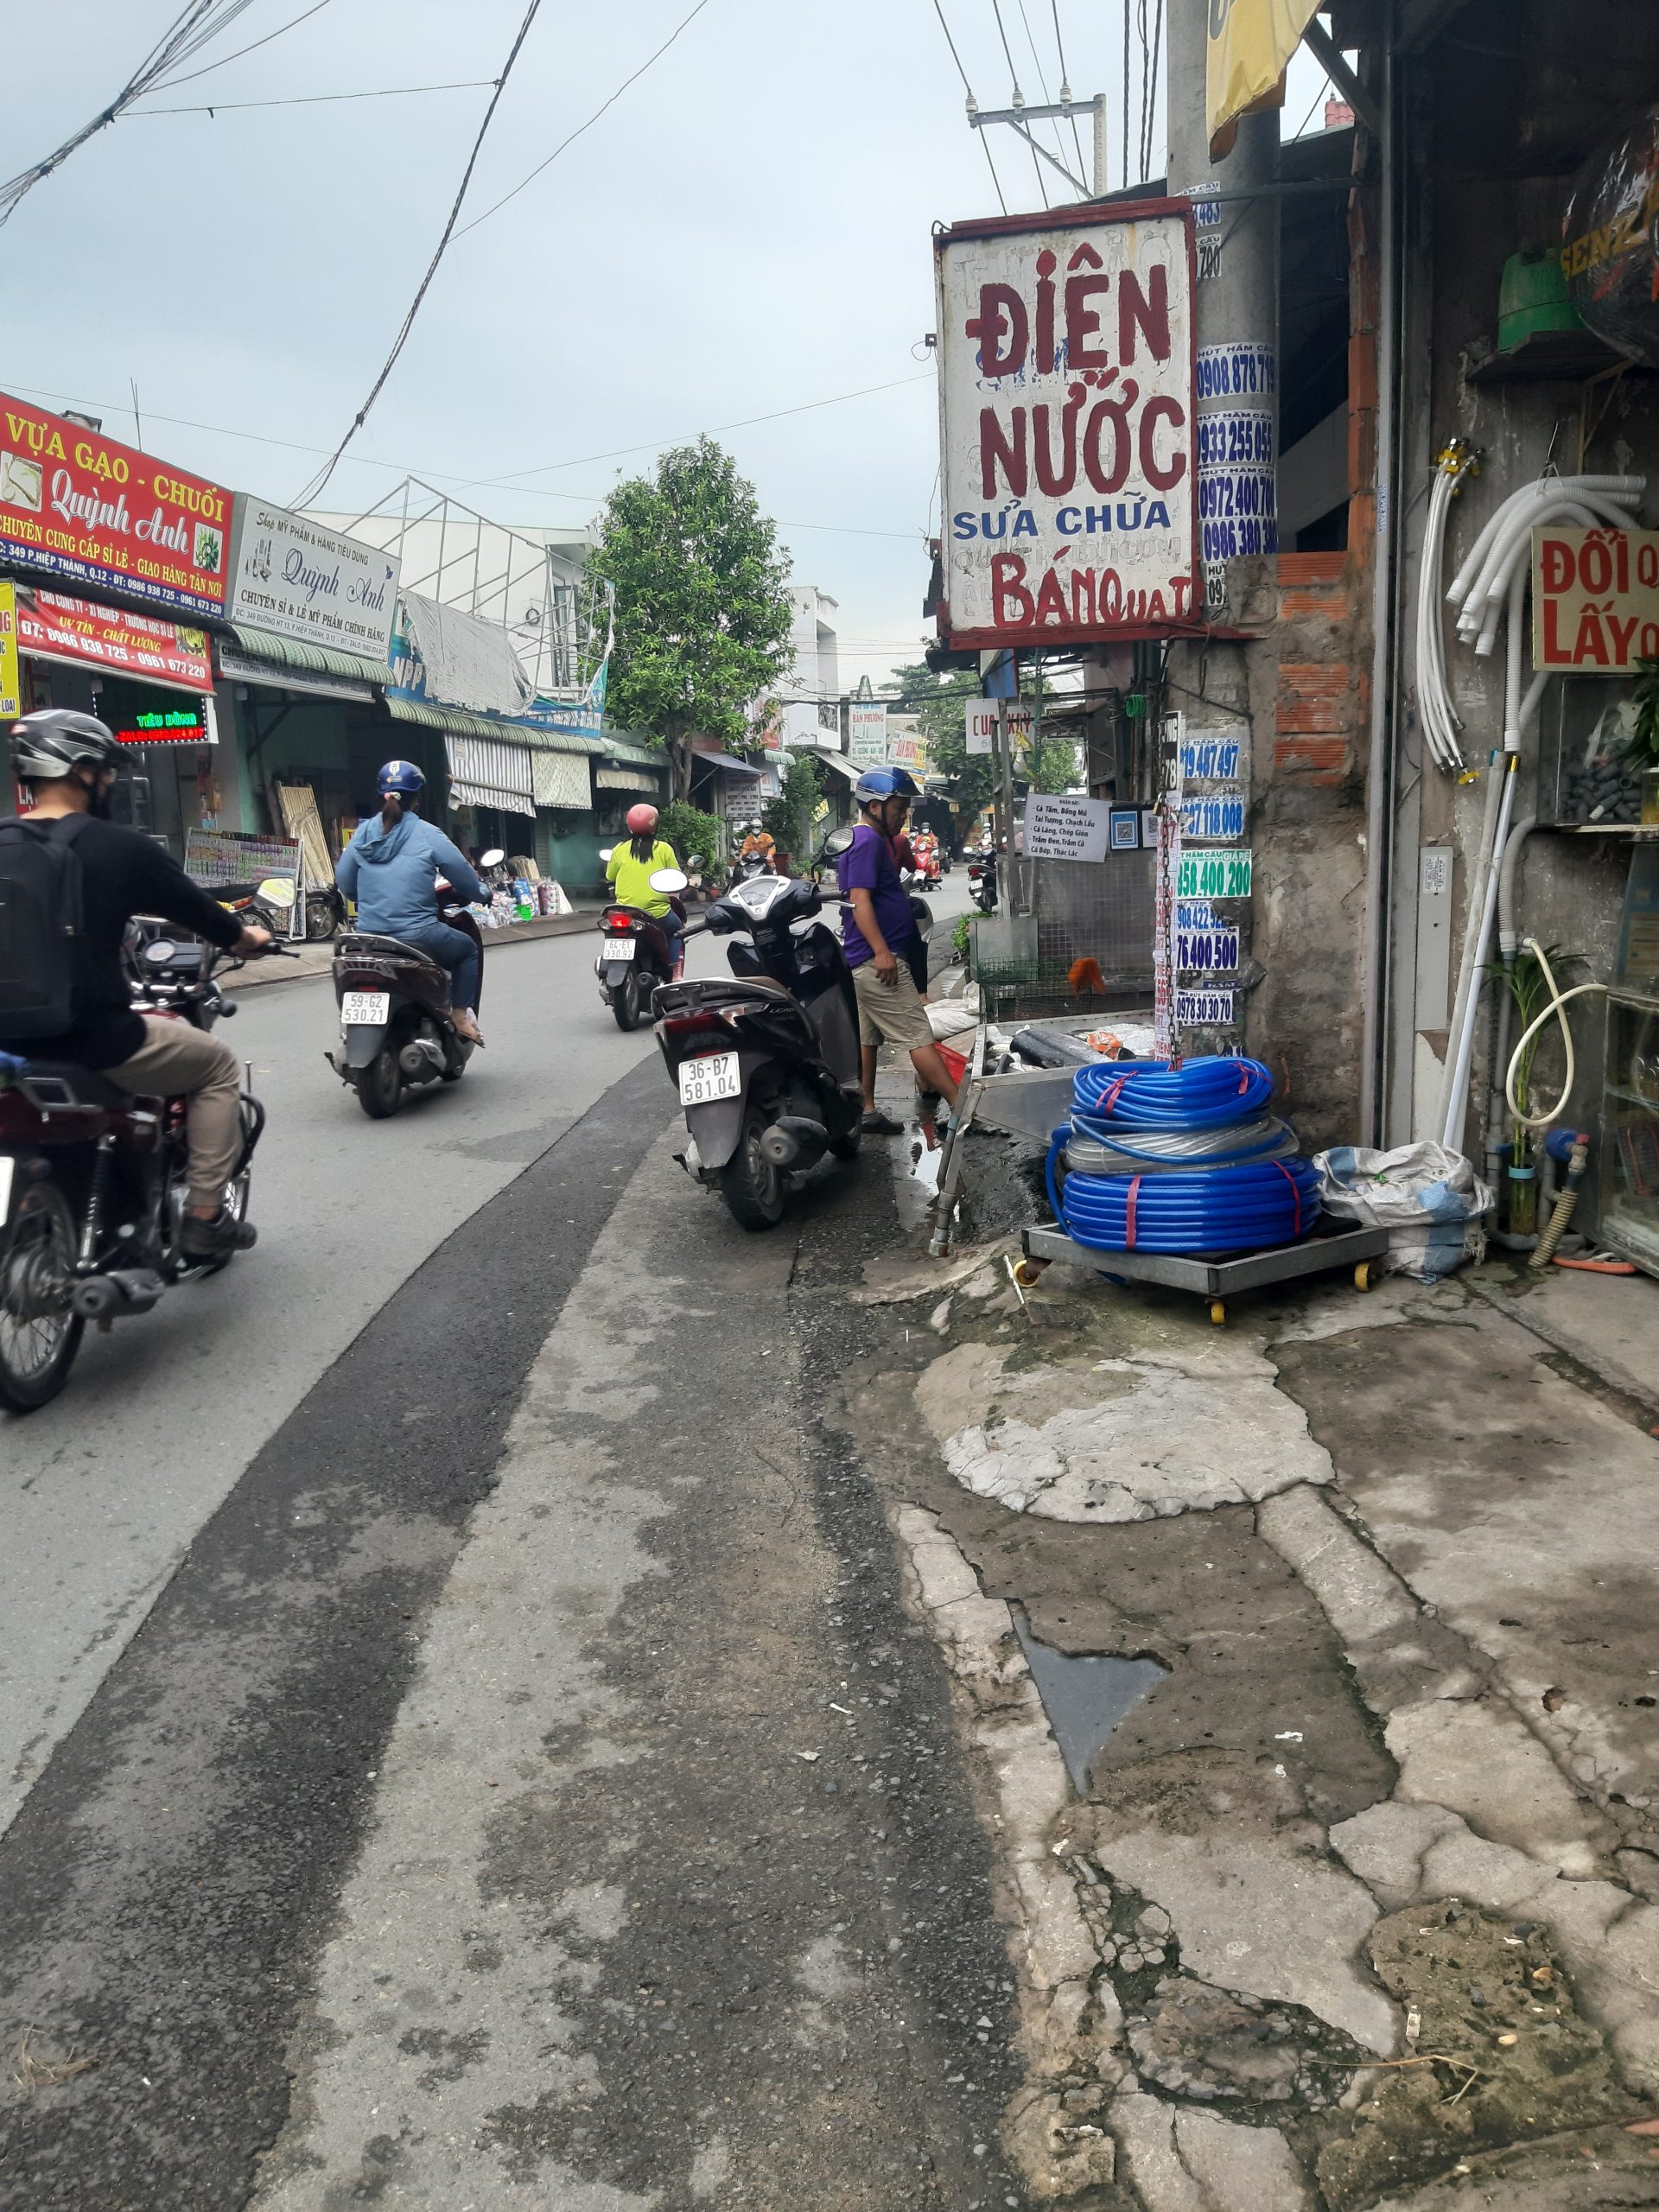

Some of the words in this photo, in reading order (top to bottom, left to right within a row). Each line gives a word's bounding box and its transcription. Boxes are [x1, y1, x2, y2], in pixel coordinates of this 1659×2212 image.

[1198, 347, 1221, 358] HÚT
[979, 366, 1187, 499] NƯỚC
[5, 411, 67, 461] VỰA
[74, 442, 130, 484] GẠO
[153, 474, 225, 523] CHUỐI
[51, 468, 130, 535] Quỳnh
[135, 506, 189, 555] Anh
[953, 499, 1038, 540] SỬA
[1056, 490, 1172, 537] CHỮA
[45, 528, 76, 552] CUNG
[79, 534, 100, 560] CẤP
[115, 546, 129, 569] LẺ
[137, 557, 160, 579] GIAO
[162, 563, 188, 588] HÀNG
[189, 572, 207, 594] TẬN
[207, 580, 223, 598] NƠI
[256, 512, 275, 531] Shop
[276, 521, 289, 534] MỸ
[289, 524, 310, 543] PHẨM
[317, 537, 336, 553] HÀNG
[337, 544, 351, 558] TIÊU
[351, 548, 369, 566] DÙNG
[1540, 529, 1630, 595] ĐỔI
[9, 543, 26, 559] 349
[27, 549, 57, 568] P.HIỆP
[57, 558, 88, 578] THÀNH,
[89, 567, 108, 582] Q.12
[112, 573, 126, 588] ĐT:
[127, 578, 146, 593] 0986
[147, 584, 161, 597] 938
[162, 588, 175, 601] 725
[180, 594, 196, 607] 0961
[197, 599, 210, 610] 673
[210, 603, 223, 614] 220
[40, 589, 55, 603] CHO
[54, 593, 76, 612] CÔNG
[74, 597, 84, 614] TY
[280, 547, 340, 603] Quỳnh
[346, 577, 385, 612] Anh
[991, 544, 1096, 629] BÁN
[59, 615, 75, 628] UY
[102, 628, 129, 645] CHẤT
[130, 637, 162, 654] LƯỢNG
[240, 589, 276, 610] CHUYÊN
[288, 602, 295, 615] &
[296, 604, 308, 620] LẺ
[308, 609, 321, 623] MỸ
[321, 611, 344, 631] PHẨM
[345, 619, 366, 637] CHÍNH
[246, 611, 257, 620] 349
[1542, 599, 1641, 666] LẤY
[47, 626, 79, 649] 0986
[79, 637, 104, 656] 938
[104, 643, 129, 662] 725
[137, 652, 167, 670] 0961
[168, 659, 188, 675] 673
[188, 663, 207, 679] 220
[343, 1008, 384, 1022] 530.21
[350, 995, 383, 1008] 59-G2
[684, 1074, 736, 1102] 581.04
[688, 1055, 729, 1082] 36-B7
